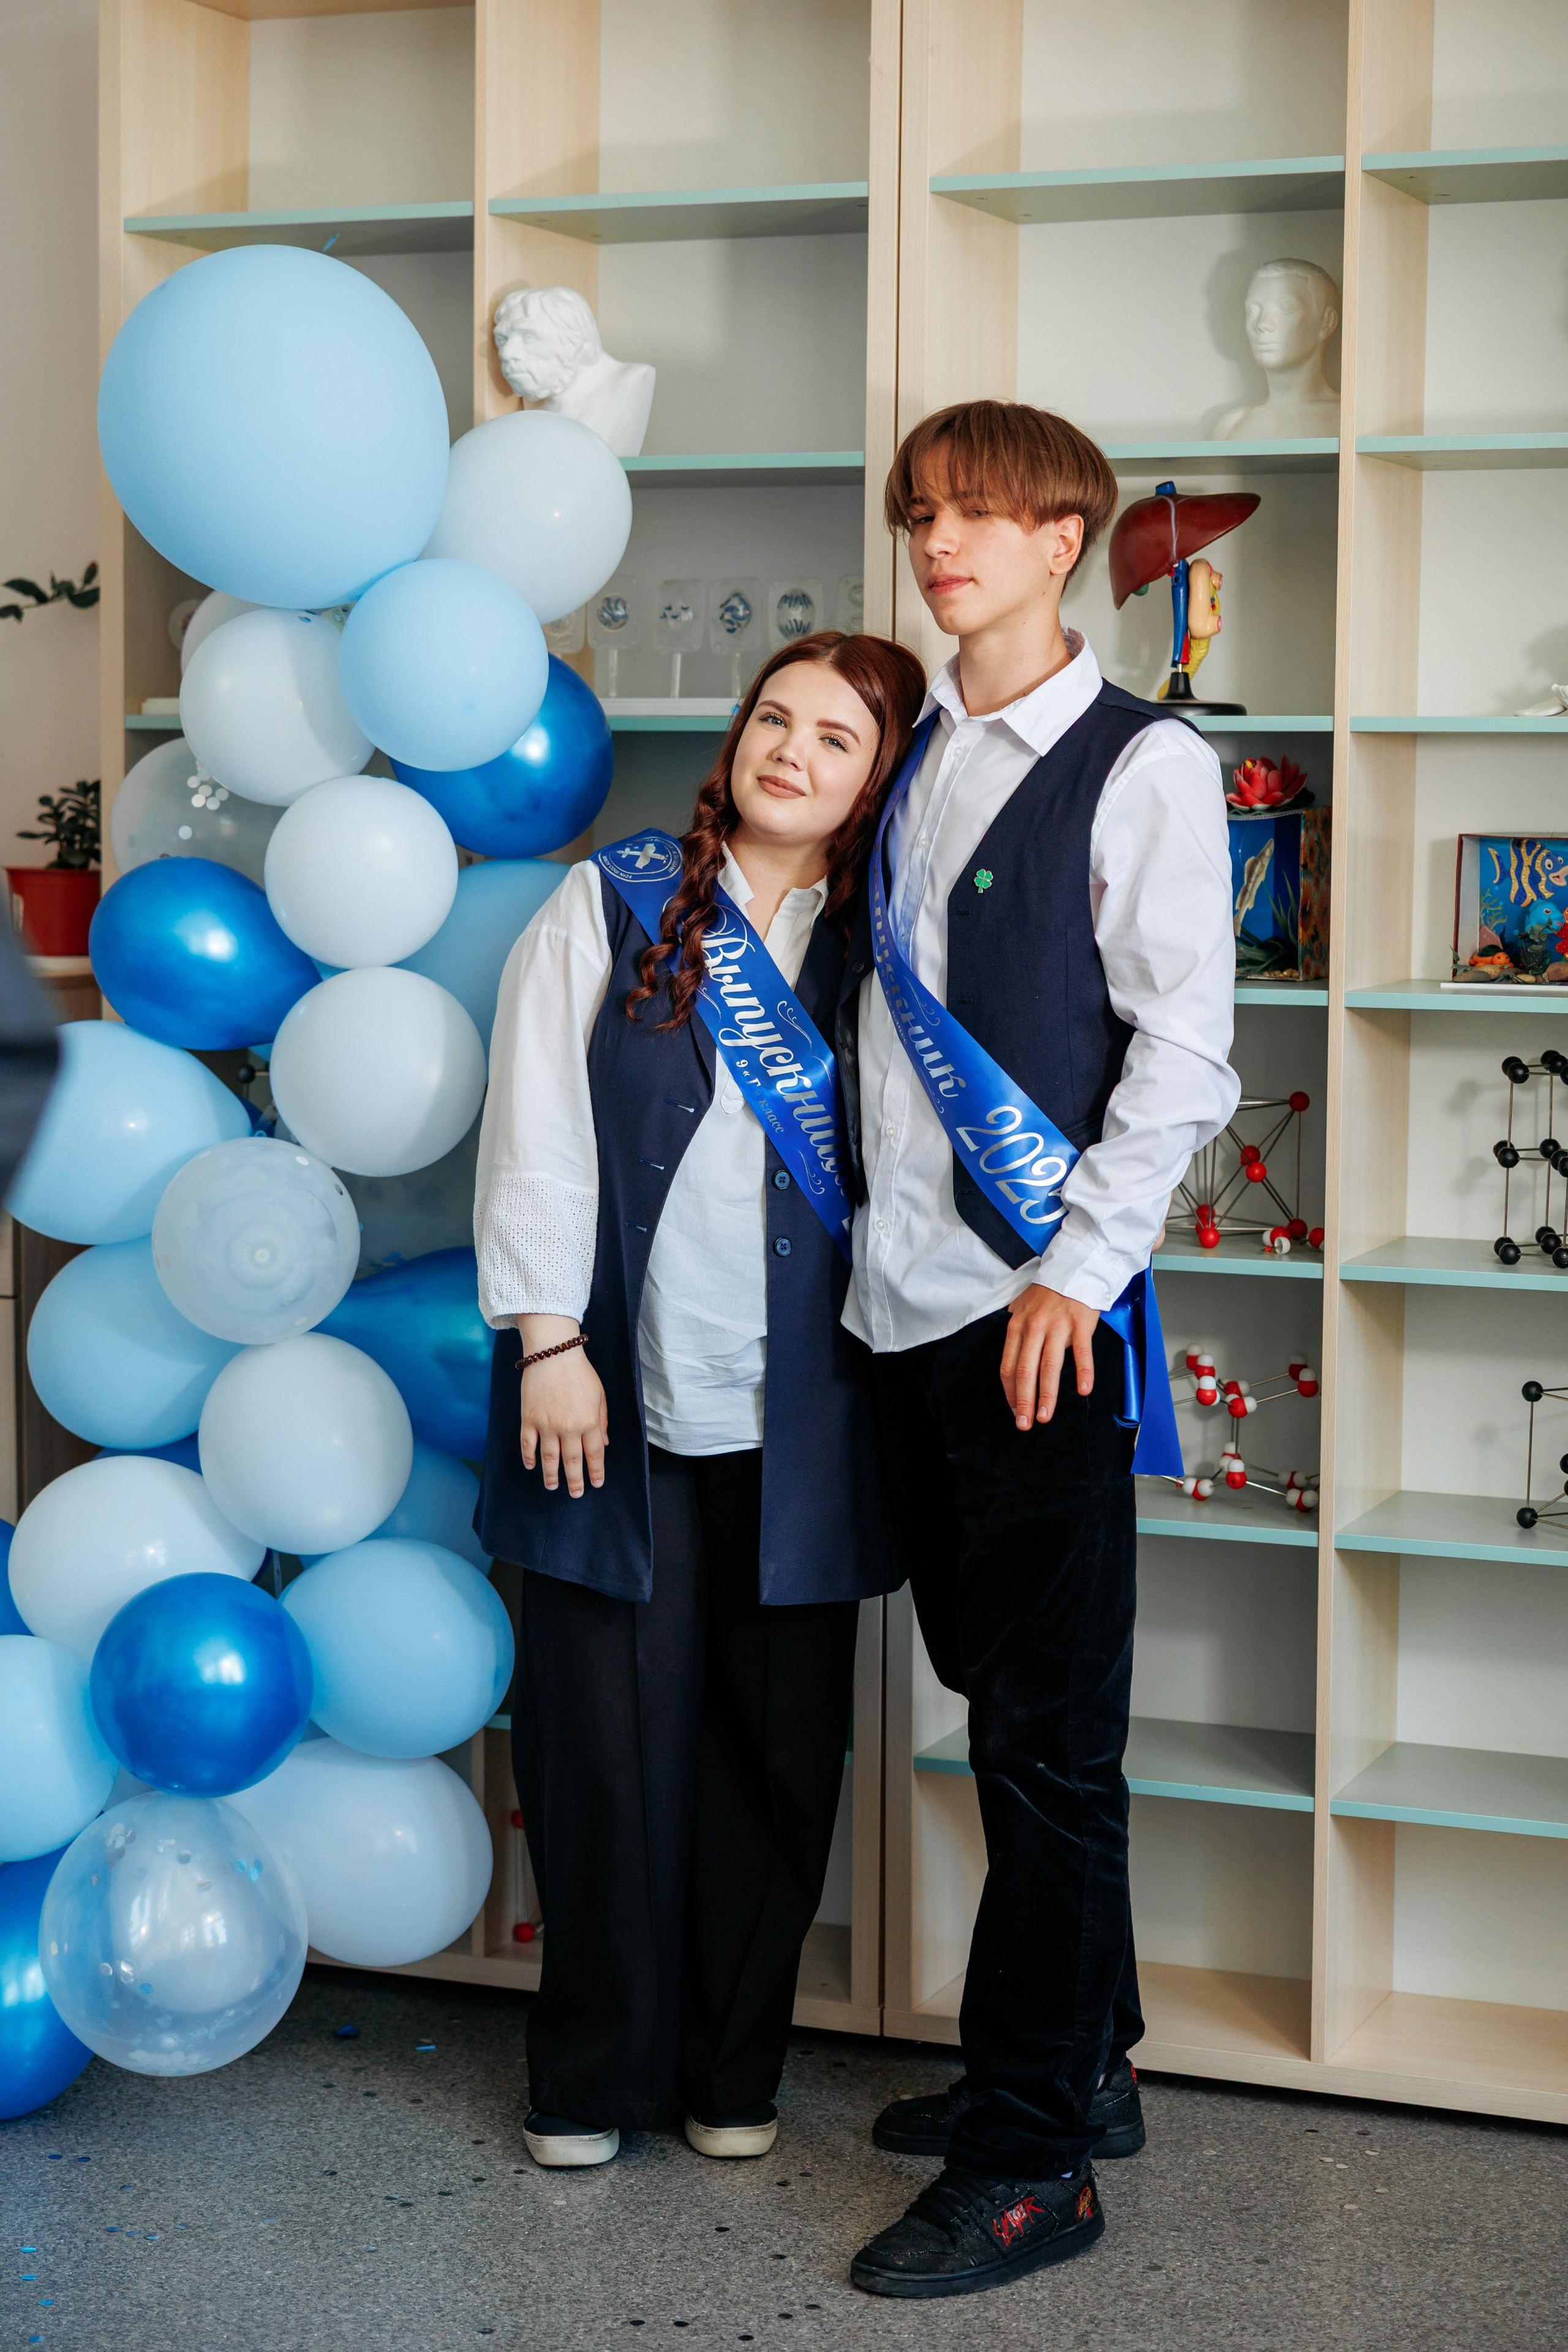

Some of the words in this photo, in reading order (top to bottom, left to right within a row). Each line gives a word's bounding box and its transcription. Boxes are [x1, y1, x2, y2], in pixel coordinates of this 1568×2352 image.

[609, 865, 620, 875] СОШ
[736, 1059, 748, 1068] 9
[758, 1098, 785, 1134] класс
